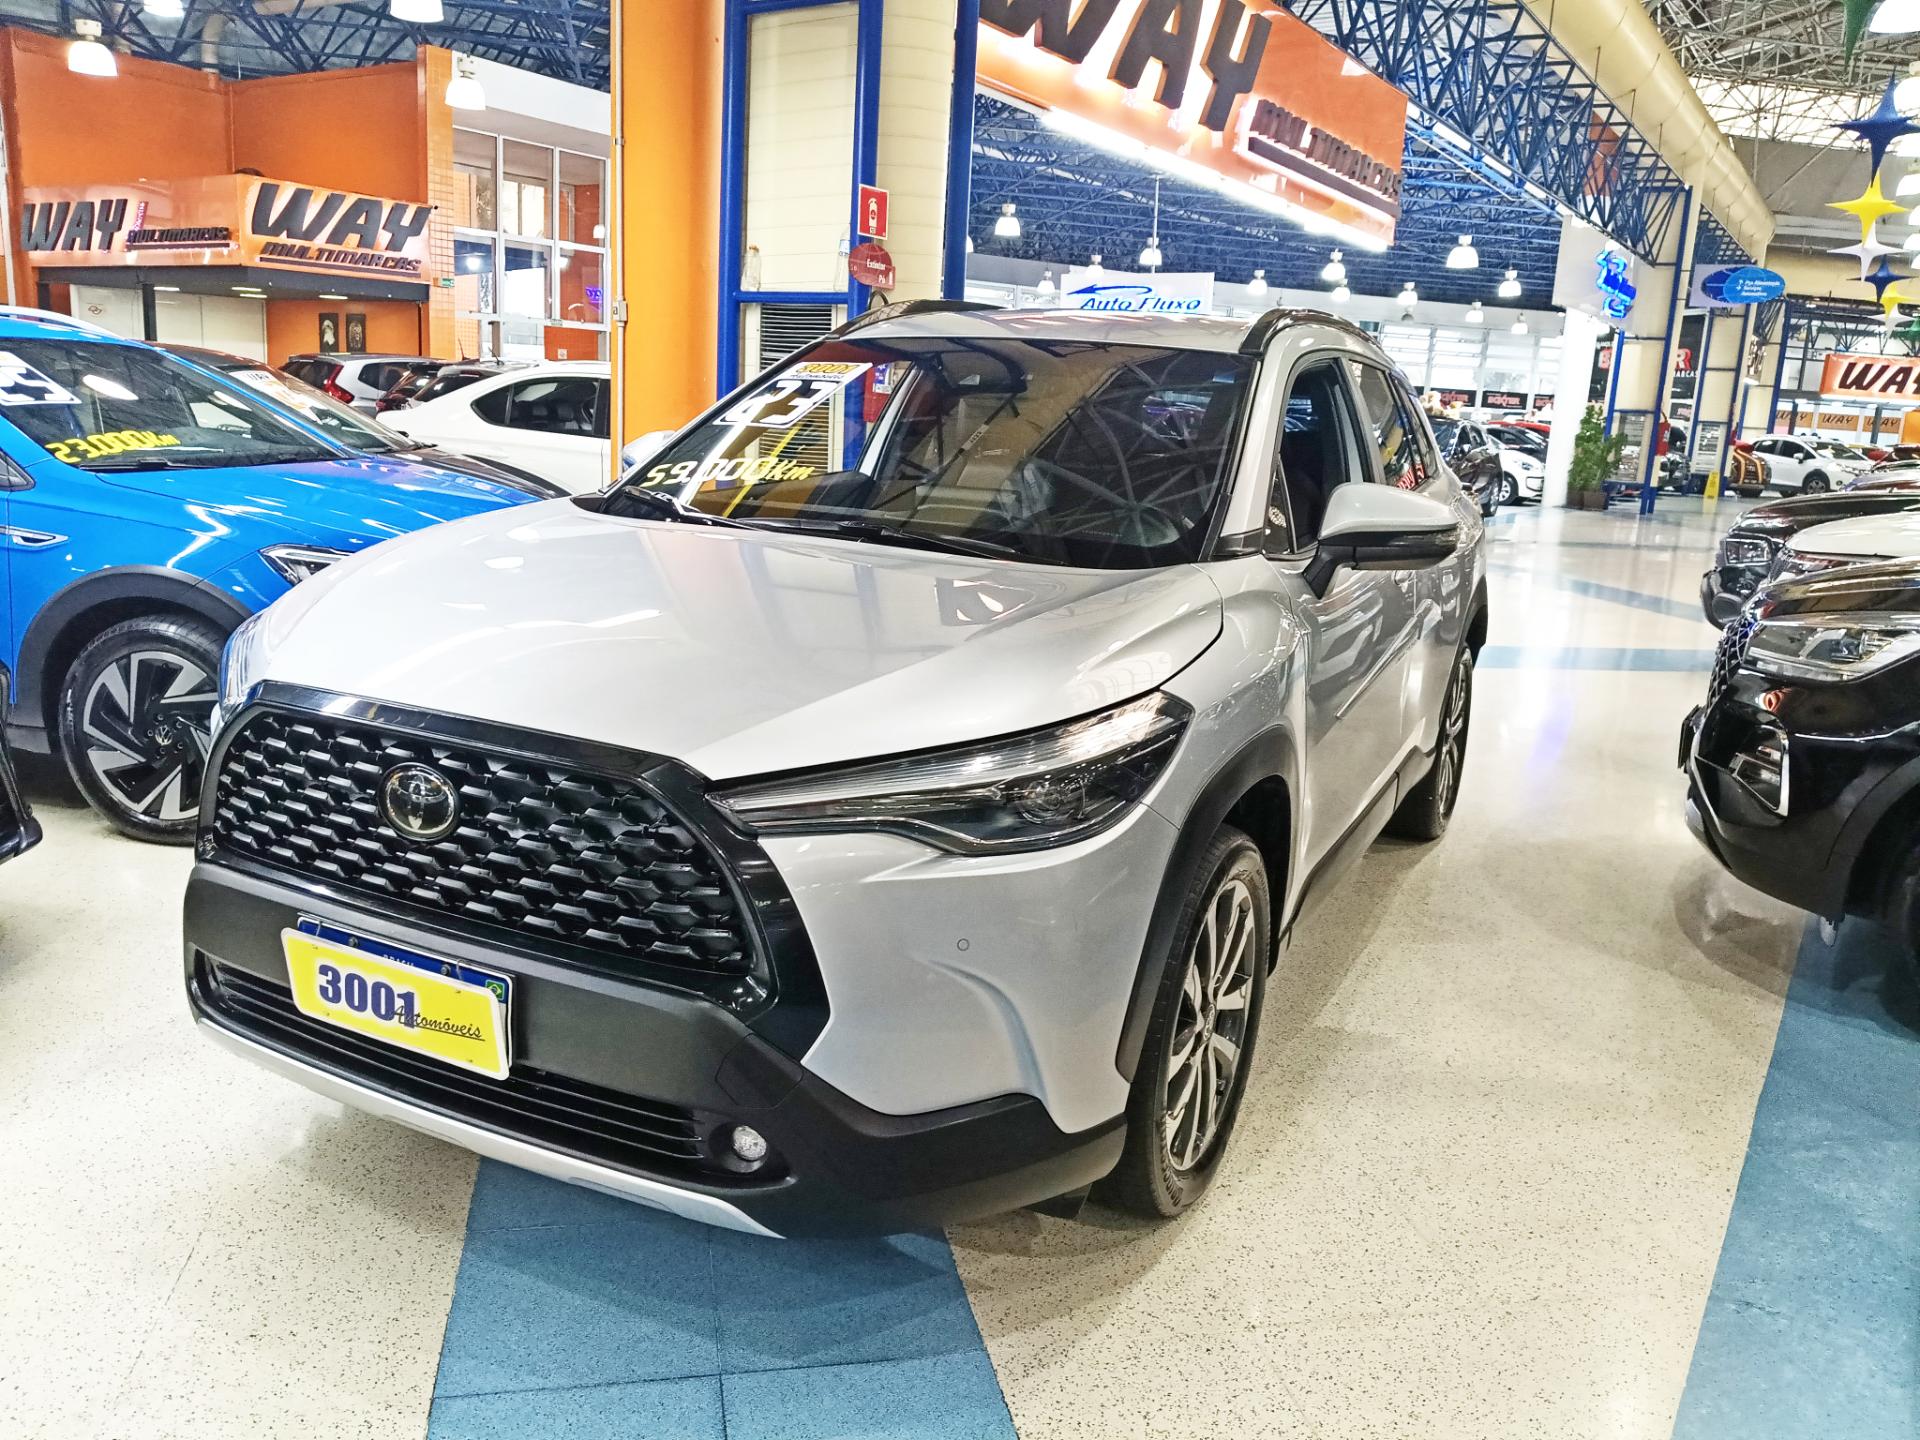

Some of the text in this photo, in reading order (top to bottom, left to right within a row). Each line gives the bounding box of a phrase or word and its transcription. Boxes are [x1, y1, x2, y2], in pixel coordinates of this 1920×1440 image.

[21, 199, 128, 251] WAY
[252, 182, 433, 252] WAY
[260, 241, 421, 272] MULTIMARCAS
[1080, 297, 1201, 312] Auto Fluxo
[1838, 362, 1920, 394] WA
[318, 964, 416, 1029] 3001
[394, 1005, 482, 1038] Automóveis
